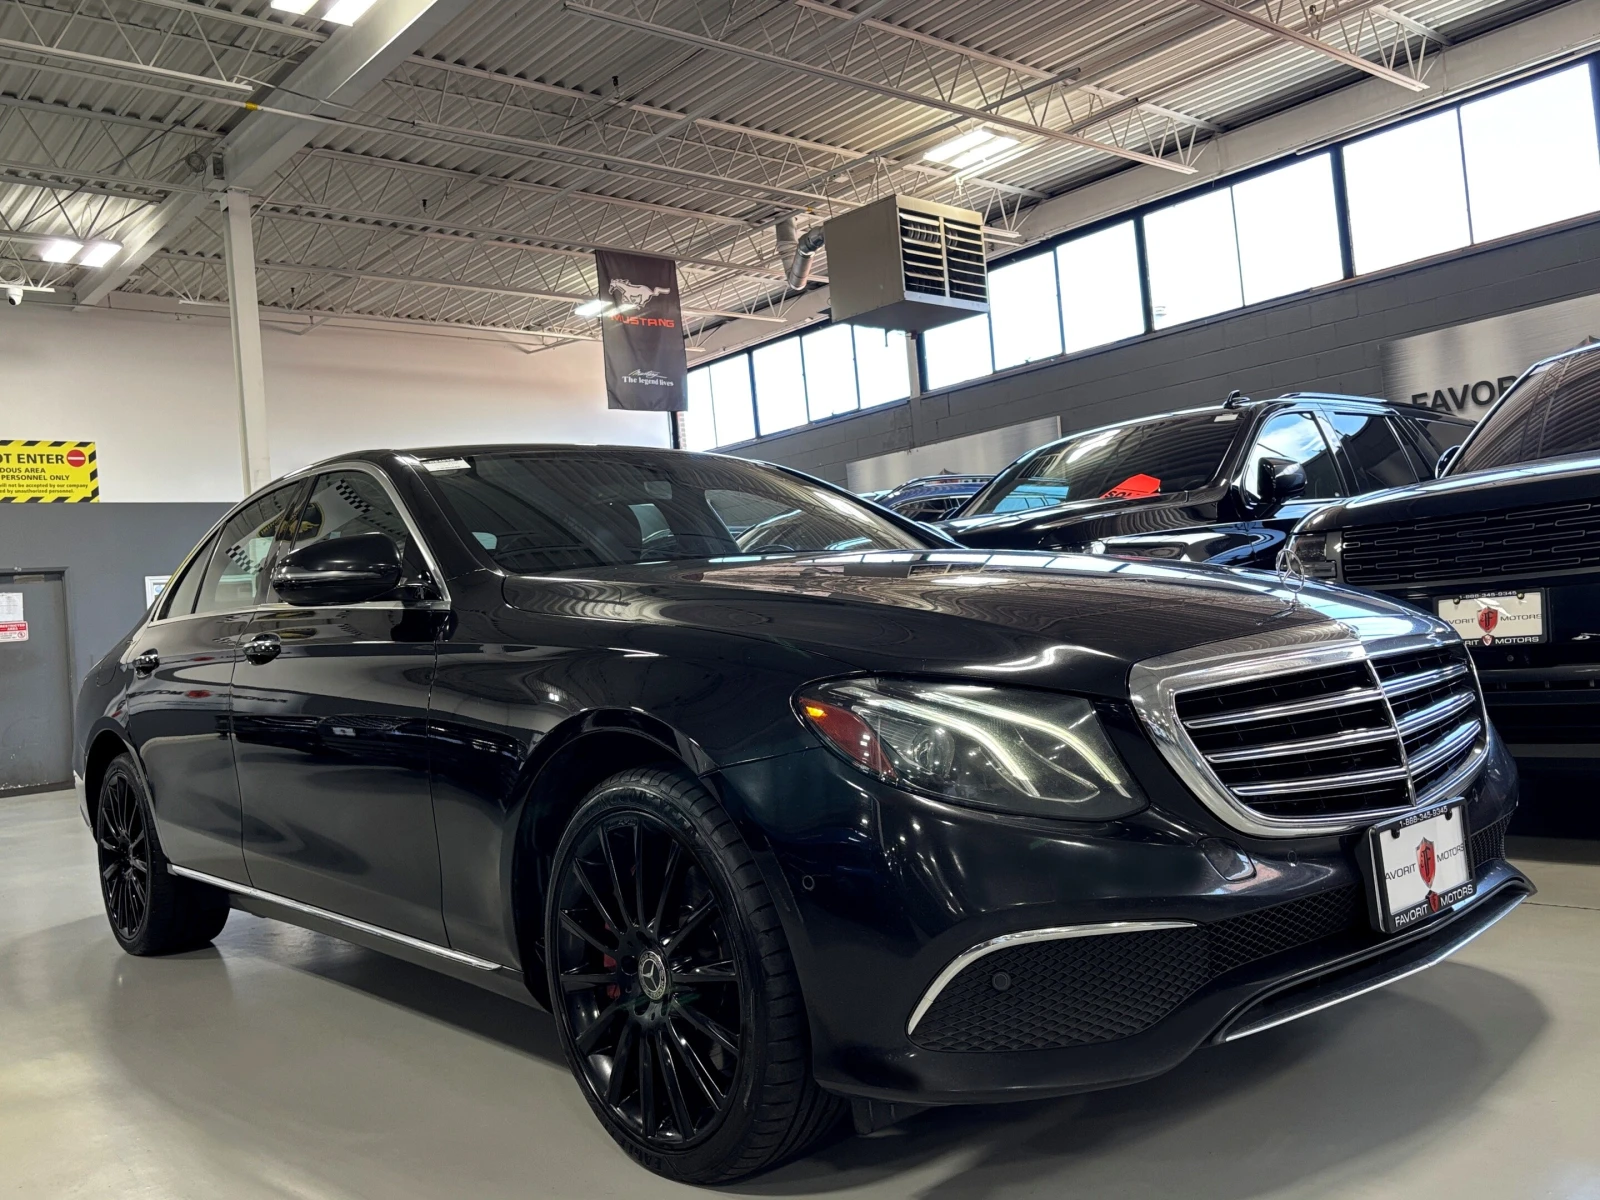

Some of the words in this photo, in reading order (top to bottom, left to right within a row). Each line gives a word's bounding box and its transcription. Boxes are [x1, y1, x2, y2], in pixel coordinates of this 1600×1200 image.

[610, 314, 675, 328] MUSTANG
[622, 375, 637, 384] The
[638, 377, 659, 387] legend
[659, 378, 674, 387] lives
[17, 453, 65, 464] ENTER
[1500, 614, 1541, 622] MOTORS
[1495, 636, 1539, 644] MOTORS
[1399, 806, 1448, 828] 1-888-345-9345
[1436, 843, 1465, 863] MOTORS
[1395, 903, 1429, 928] FAVORIT
[1440, 884, 1474, 907] MOTORS
